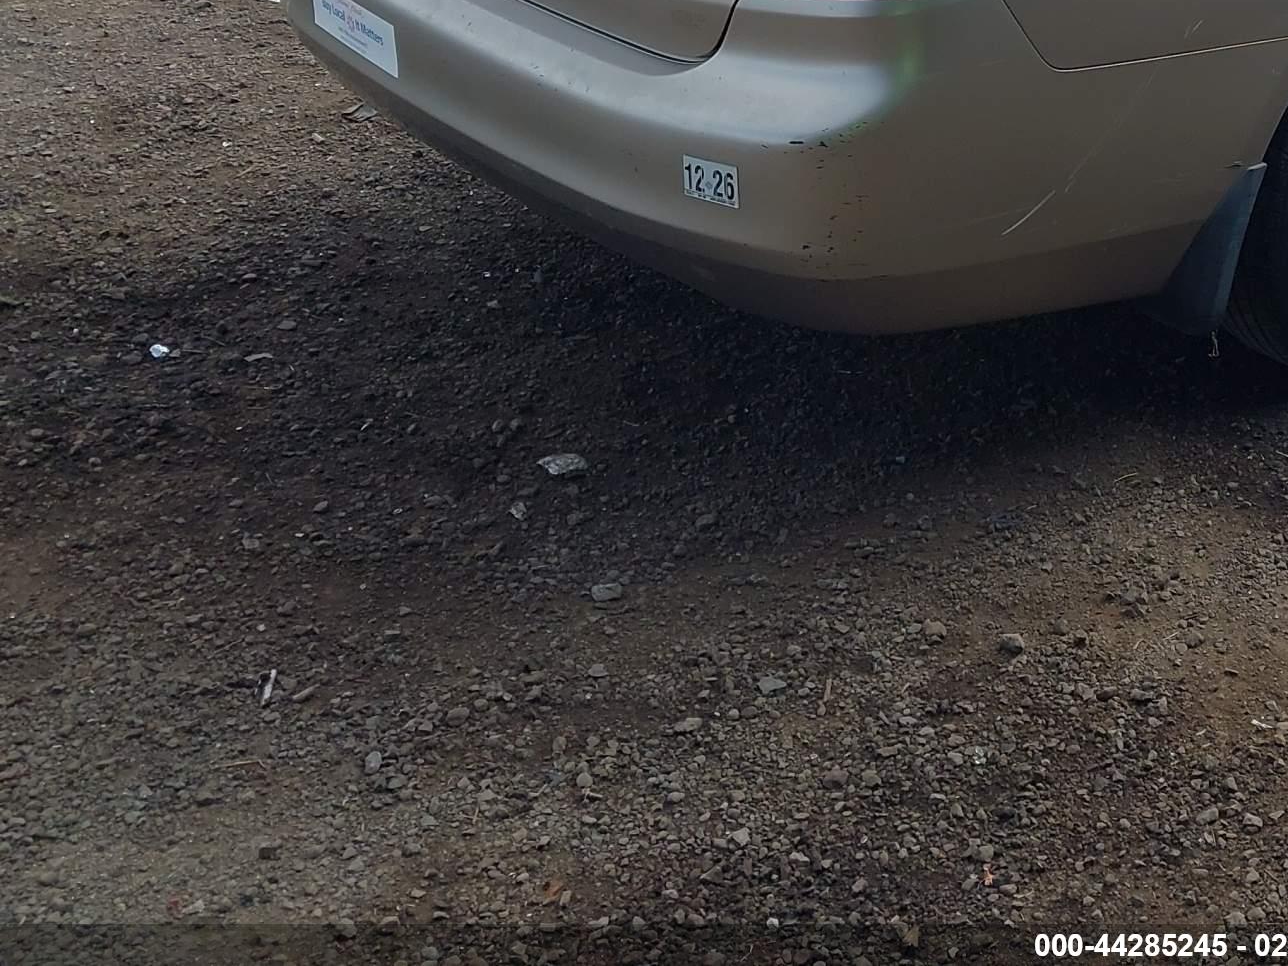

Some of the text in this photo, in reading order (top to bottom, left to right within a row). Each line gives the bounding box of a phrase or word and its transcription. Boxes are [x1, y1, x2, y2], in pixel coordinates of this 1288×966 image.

[332, 2, 345, 22] Local
[360, 23, 384, 46] Matters
[684, 163, 706, 193] 12
[712, 169, 735, 200] 26
